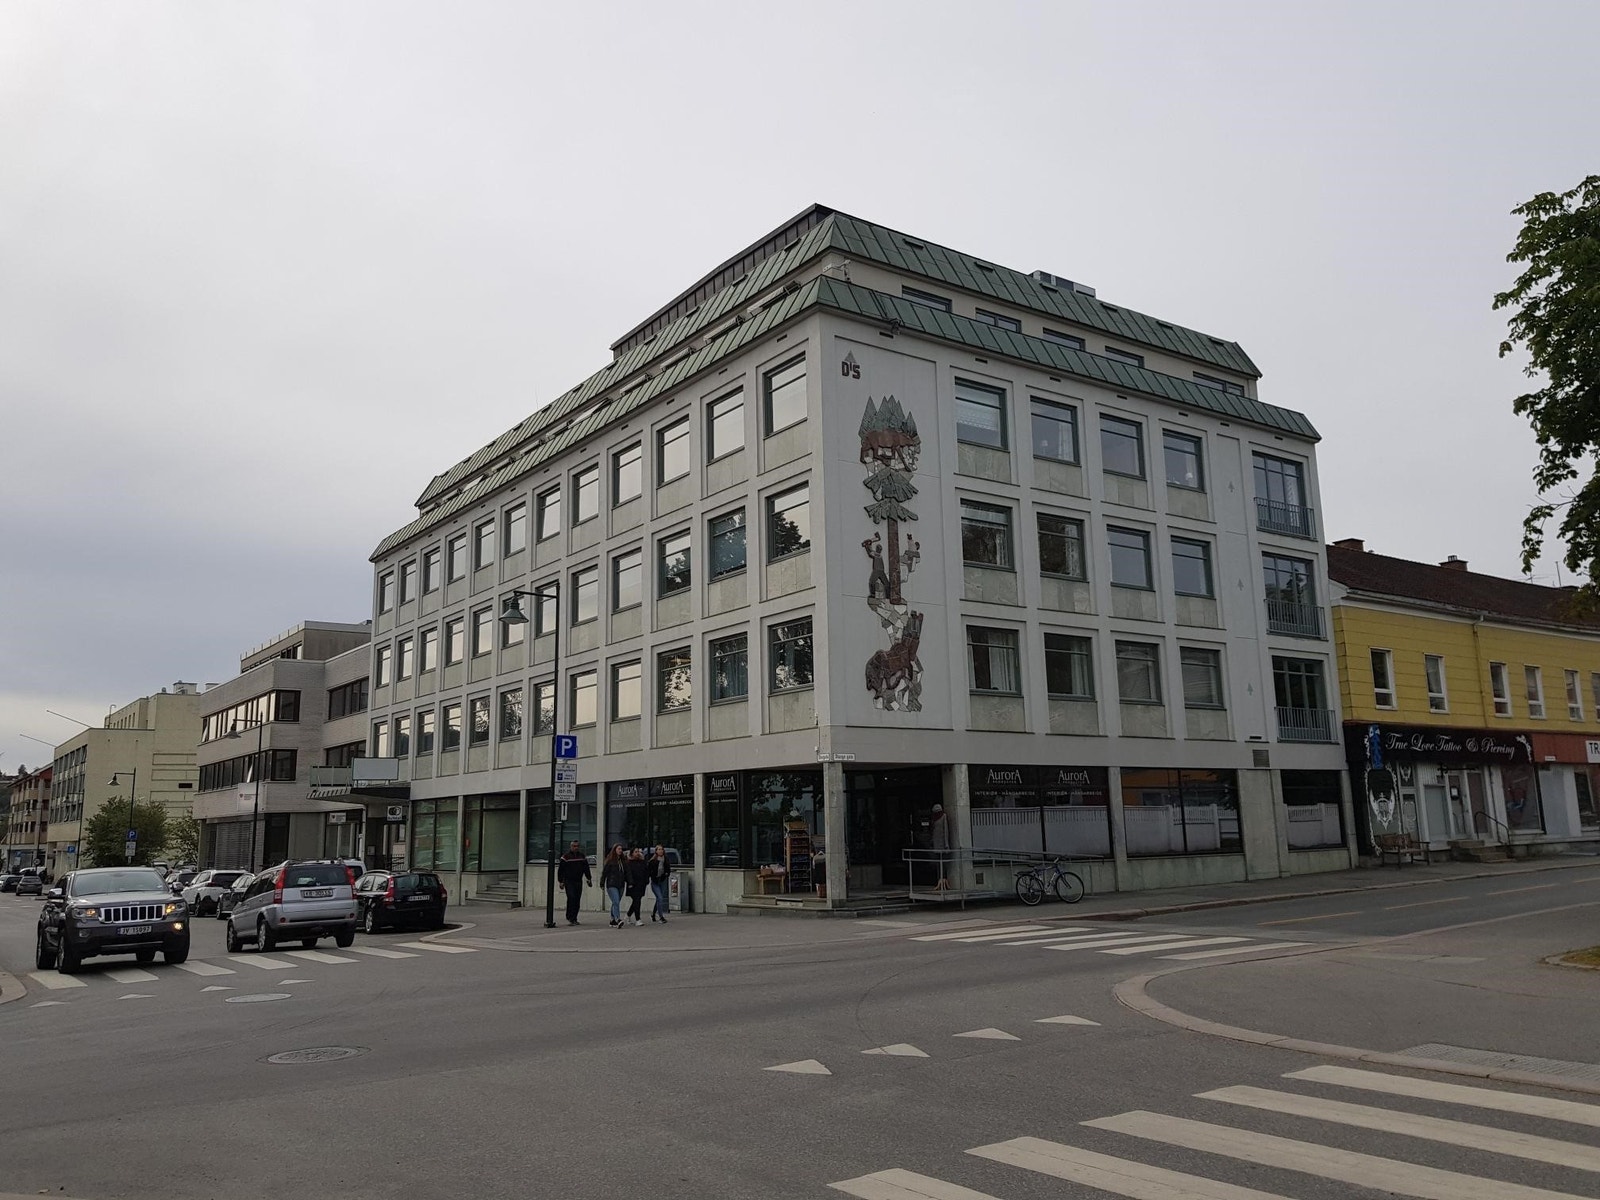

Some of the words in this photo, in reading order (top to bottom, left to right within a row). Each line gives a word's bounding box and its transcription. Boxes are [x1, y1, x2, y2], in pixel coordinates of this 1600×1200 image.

[561, 738, 573, 756] P
[1385, 733, 1408, 750] True
[1411, 733, 1434, 751] Love
[1435, 734, 1462, 752] Tattoo
[1466, 737, 1479, 753] &
[1481, 736, 1515, 760] Piercing
[1588, 742, 1600, 755] TR
